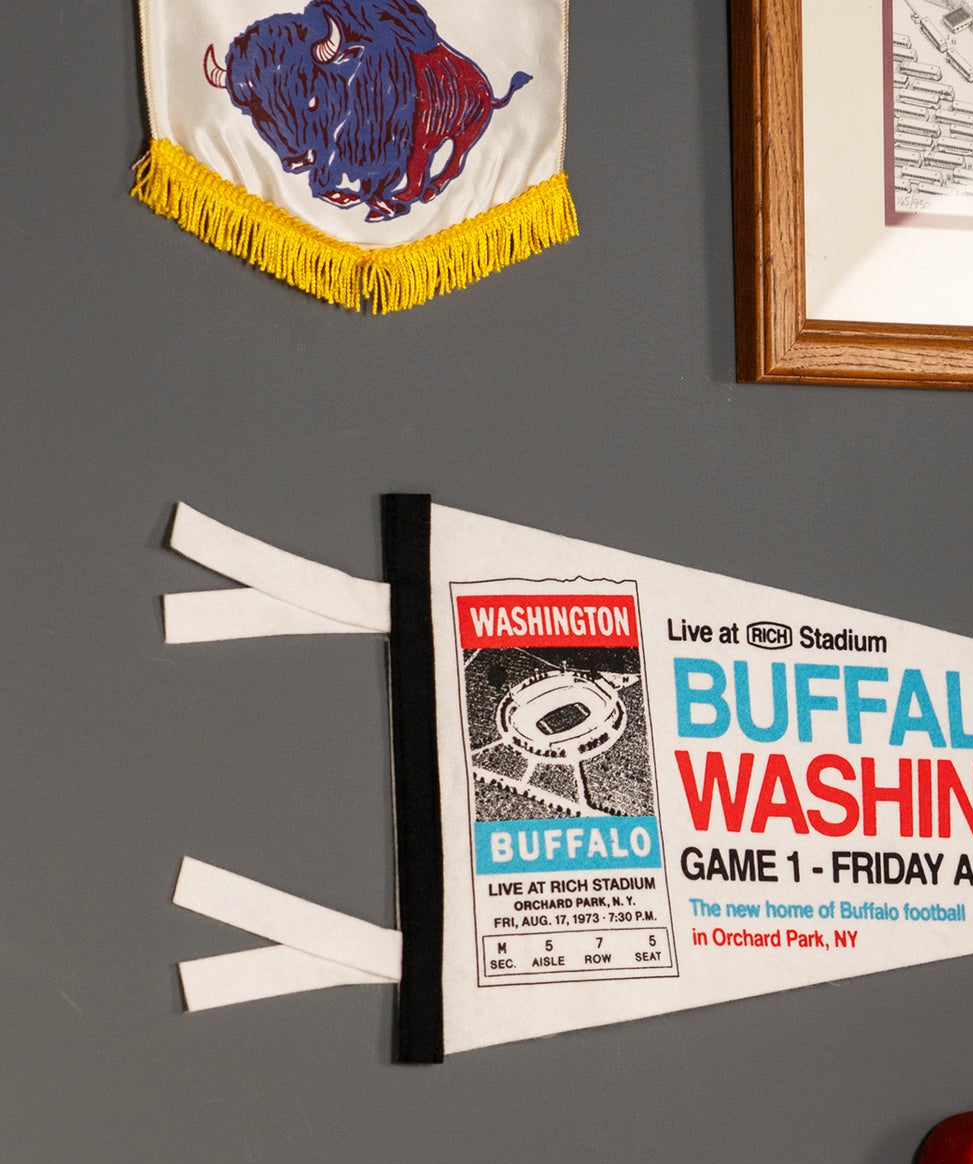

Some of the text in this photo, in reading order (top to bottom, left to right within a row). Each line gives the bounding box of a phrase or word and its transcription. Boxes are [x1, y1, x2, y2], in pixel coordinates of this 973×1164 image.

[470, 605, 631, 637] WASHINGTON
[667, 618, 888, 653] Live at RICH Stadium
[490, 827, 652, 863] BUFFALO
[681, 847, 776, 883] GAME
[786, 852, 800, 883] 1
[832, 851, 946, 887] FRIDAY
[488, 877, 656, 896] LIVE AT RICH STADIUM
[514, 898, 573, 912] ORCHARD
[577, 896, 609, 910] PARK,
[689, 898, 966, 922] The new home of Buffalo football
[494, 910, 658, 930] FRI, AUG. 17, 1973 7:30 P.M.
[497, 936, 657, 955] M 5 7 5
[692, 928, 858, 952] in Orchard Park, NY
[490, 951, 662, 970] SEC. AISLE ROW SEAT
